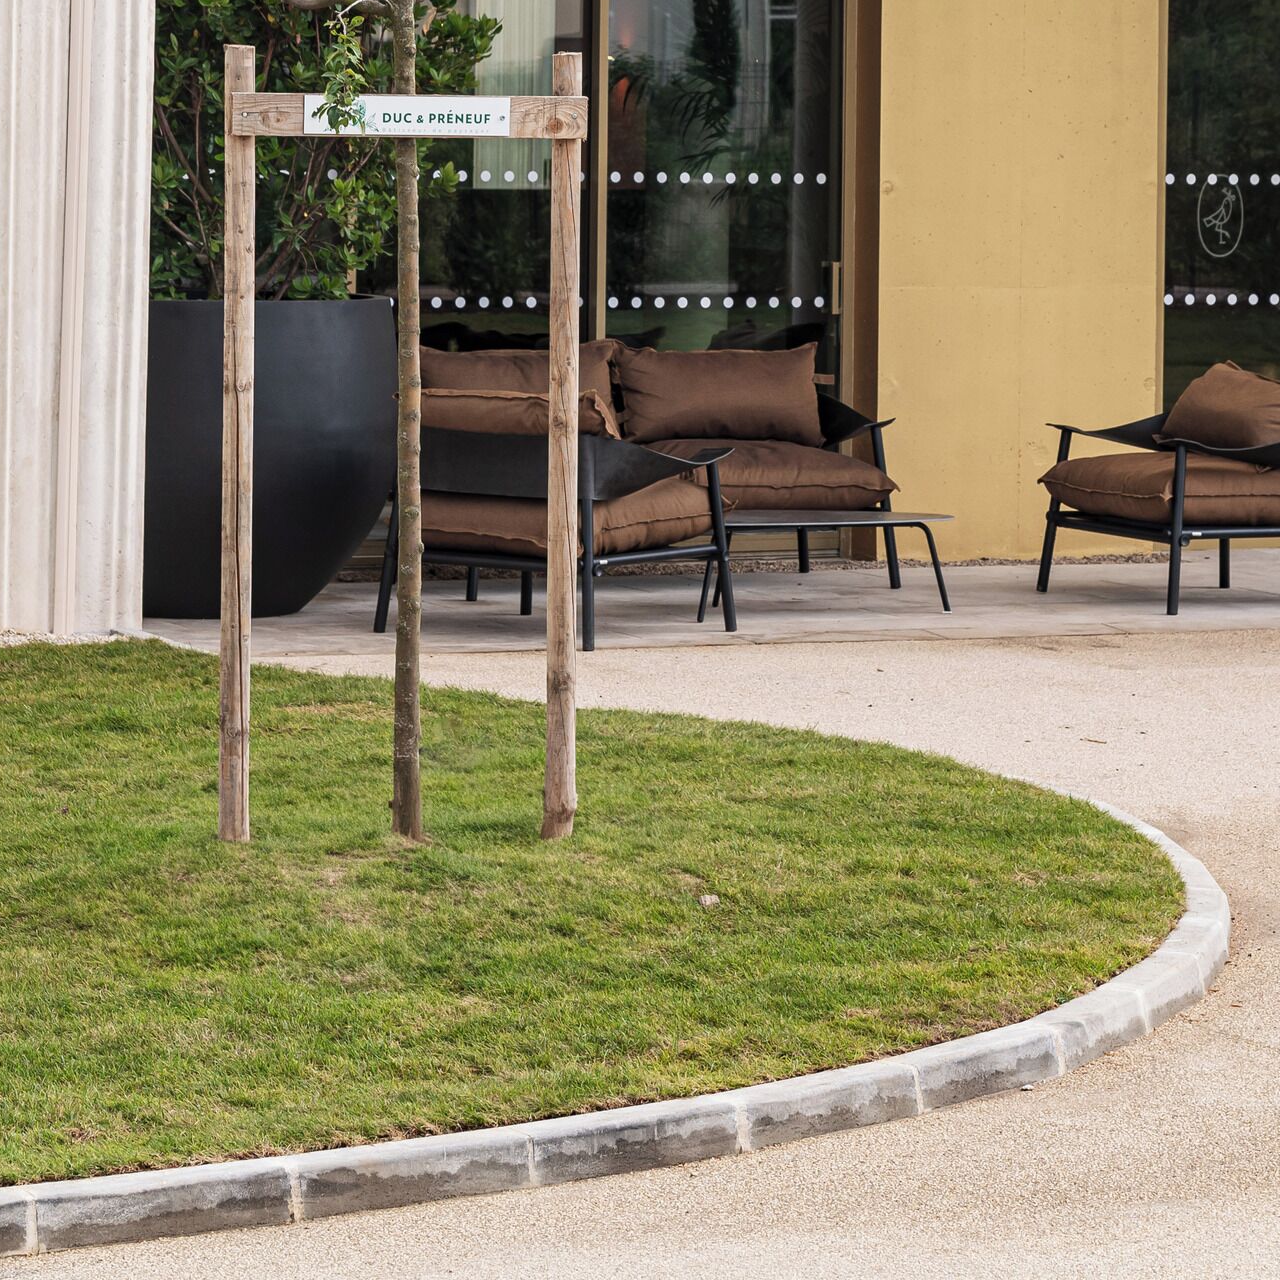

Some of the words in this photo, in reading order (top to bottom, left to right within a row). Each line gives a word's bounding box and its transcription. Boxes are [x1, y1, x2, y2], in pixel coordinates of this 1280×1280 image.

[382, 112, 412, 123] DUC
[416, 114, 424, 124] &
[429, 109, 491, 124] PRÉNEUF
